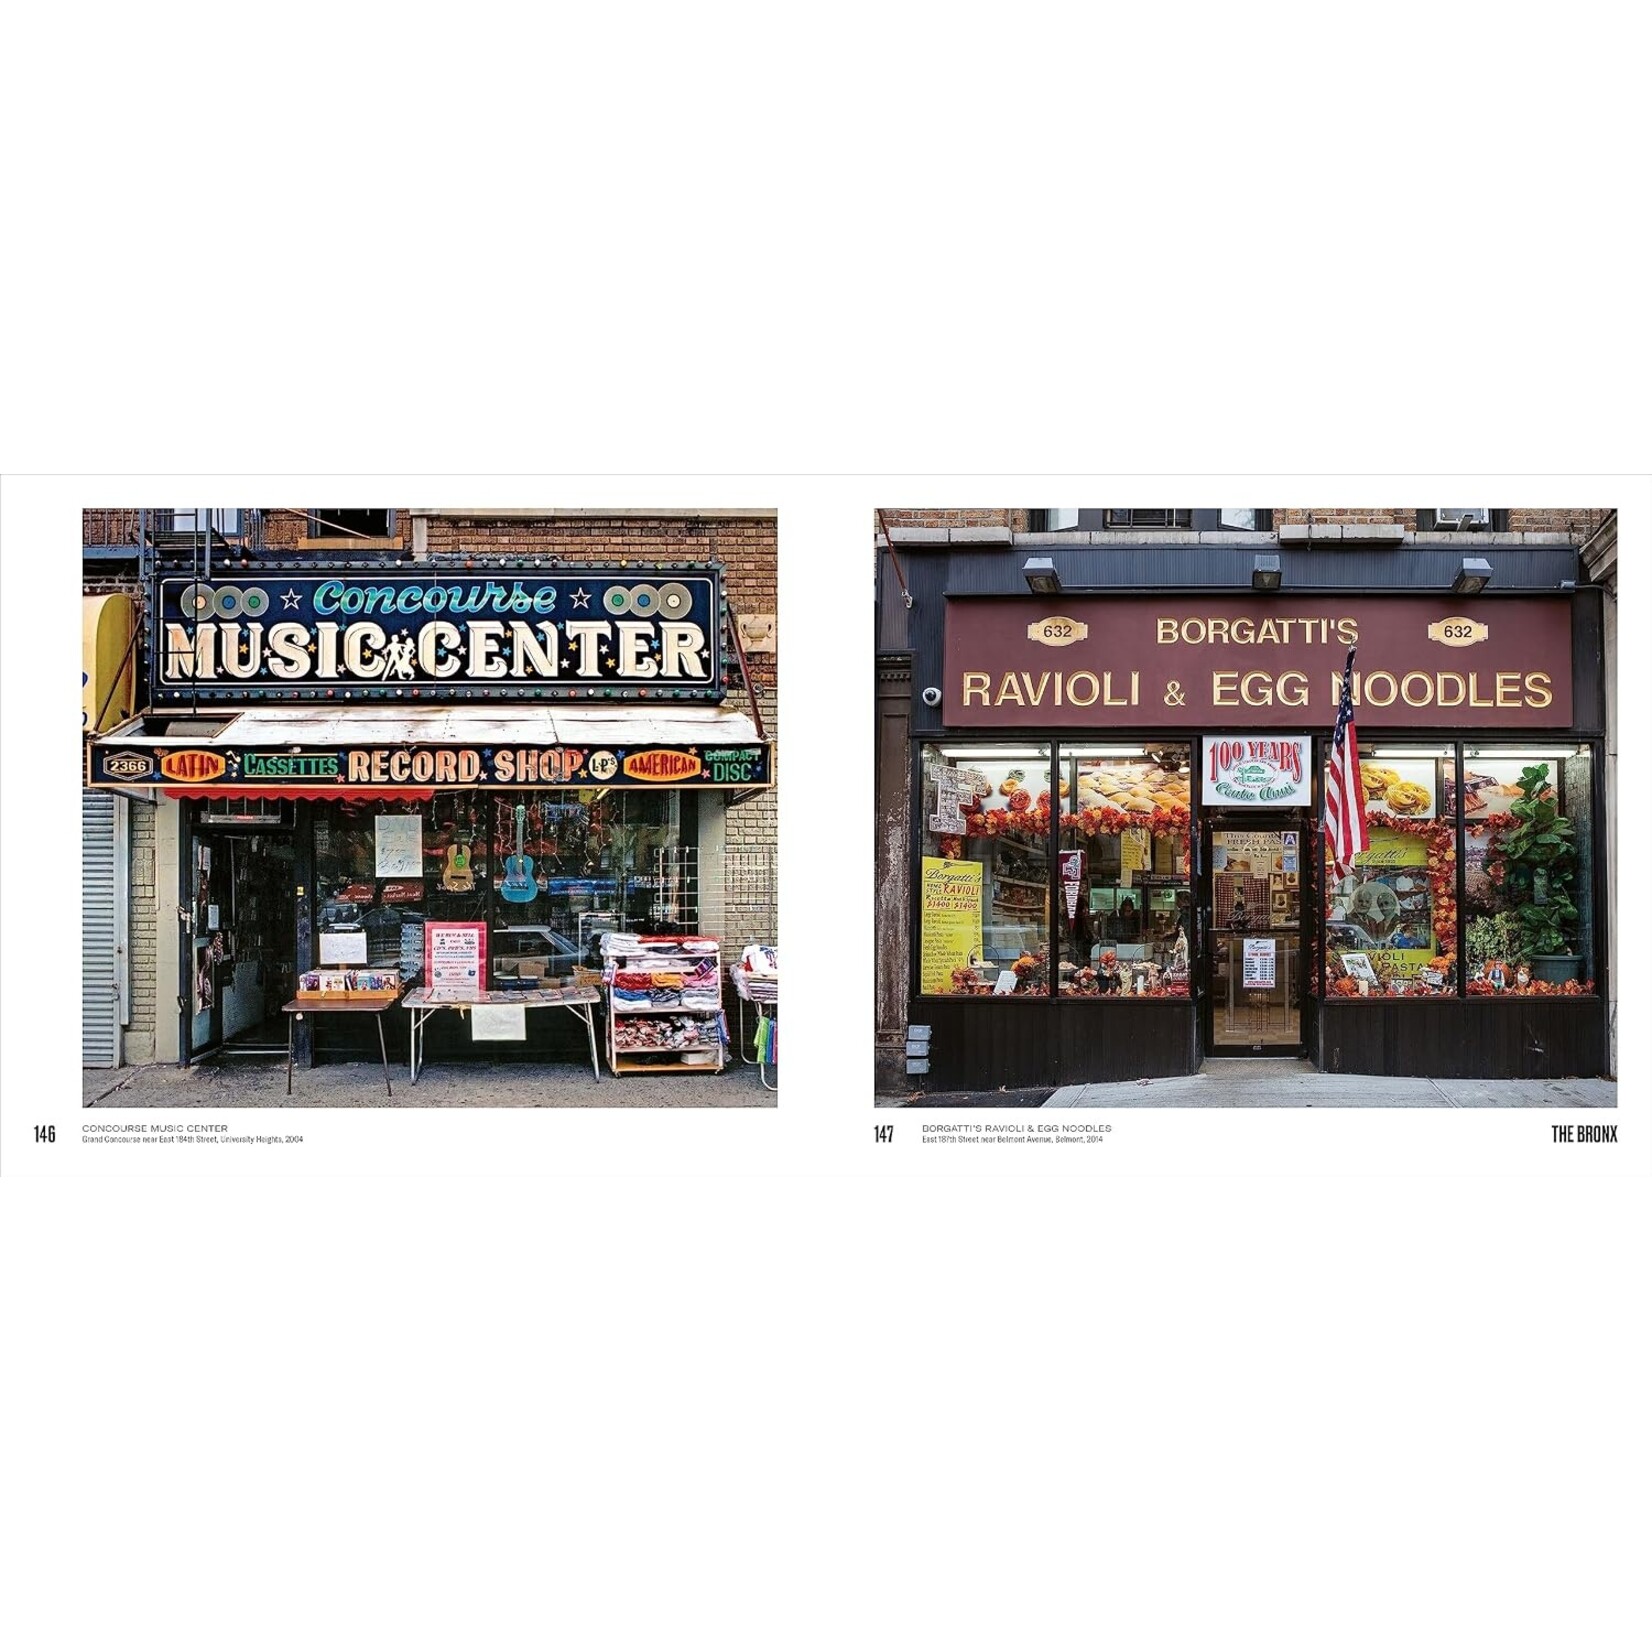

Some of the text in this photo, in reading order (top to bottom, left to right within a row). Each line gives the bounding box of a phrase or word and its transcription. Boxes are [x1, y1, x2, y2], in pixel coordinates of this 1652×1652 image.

[313, 580, 557, 615] Concourse
[1043, 624, 1072, 638] 632
[1156, 616, 1358, 645] BORGATTI'S
[1443, 624, 1472, 638] 632
[165, 620, 707, 680] MUSIC CENTER
[962, 670, 1553, 708] RAVIOLI & EGG NOODLES
[110, 761, 147, 772] 2366
[166, 754, 219, 777] LATIN
[244, 753, 338, 776] CASSETTES
[348, 750, 584, 783] RECORD SHOP
[628, 754, 697, 776] AMERICAN
[705, 750, 760, 762] COMPACT
[1209, 741, 1302, 784] 100 YEARS
[713, 762, 752, 782] DISC
[1284, 833, 1296, 845] A
[1368, 953, 1404, 961] VIOLI
